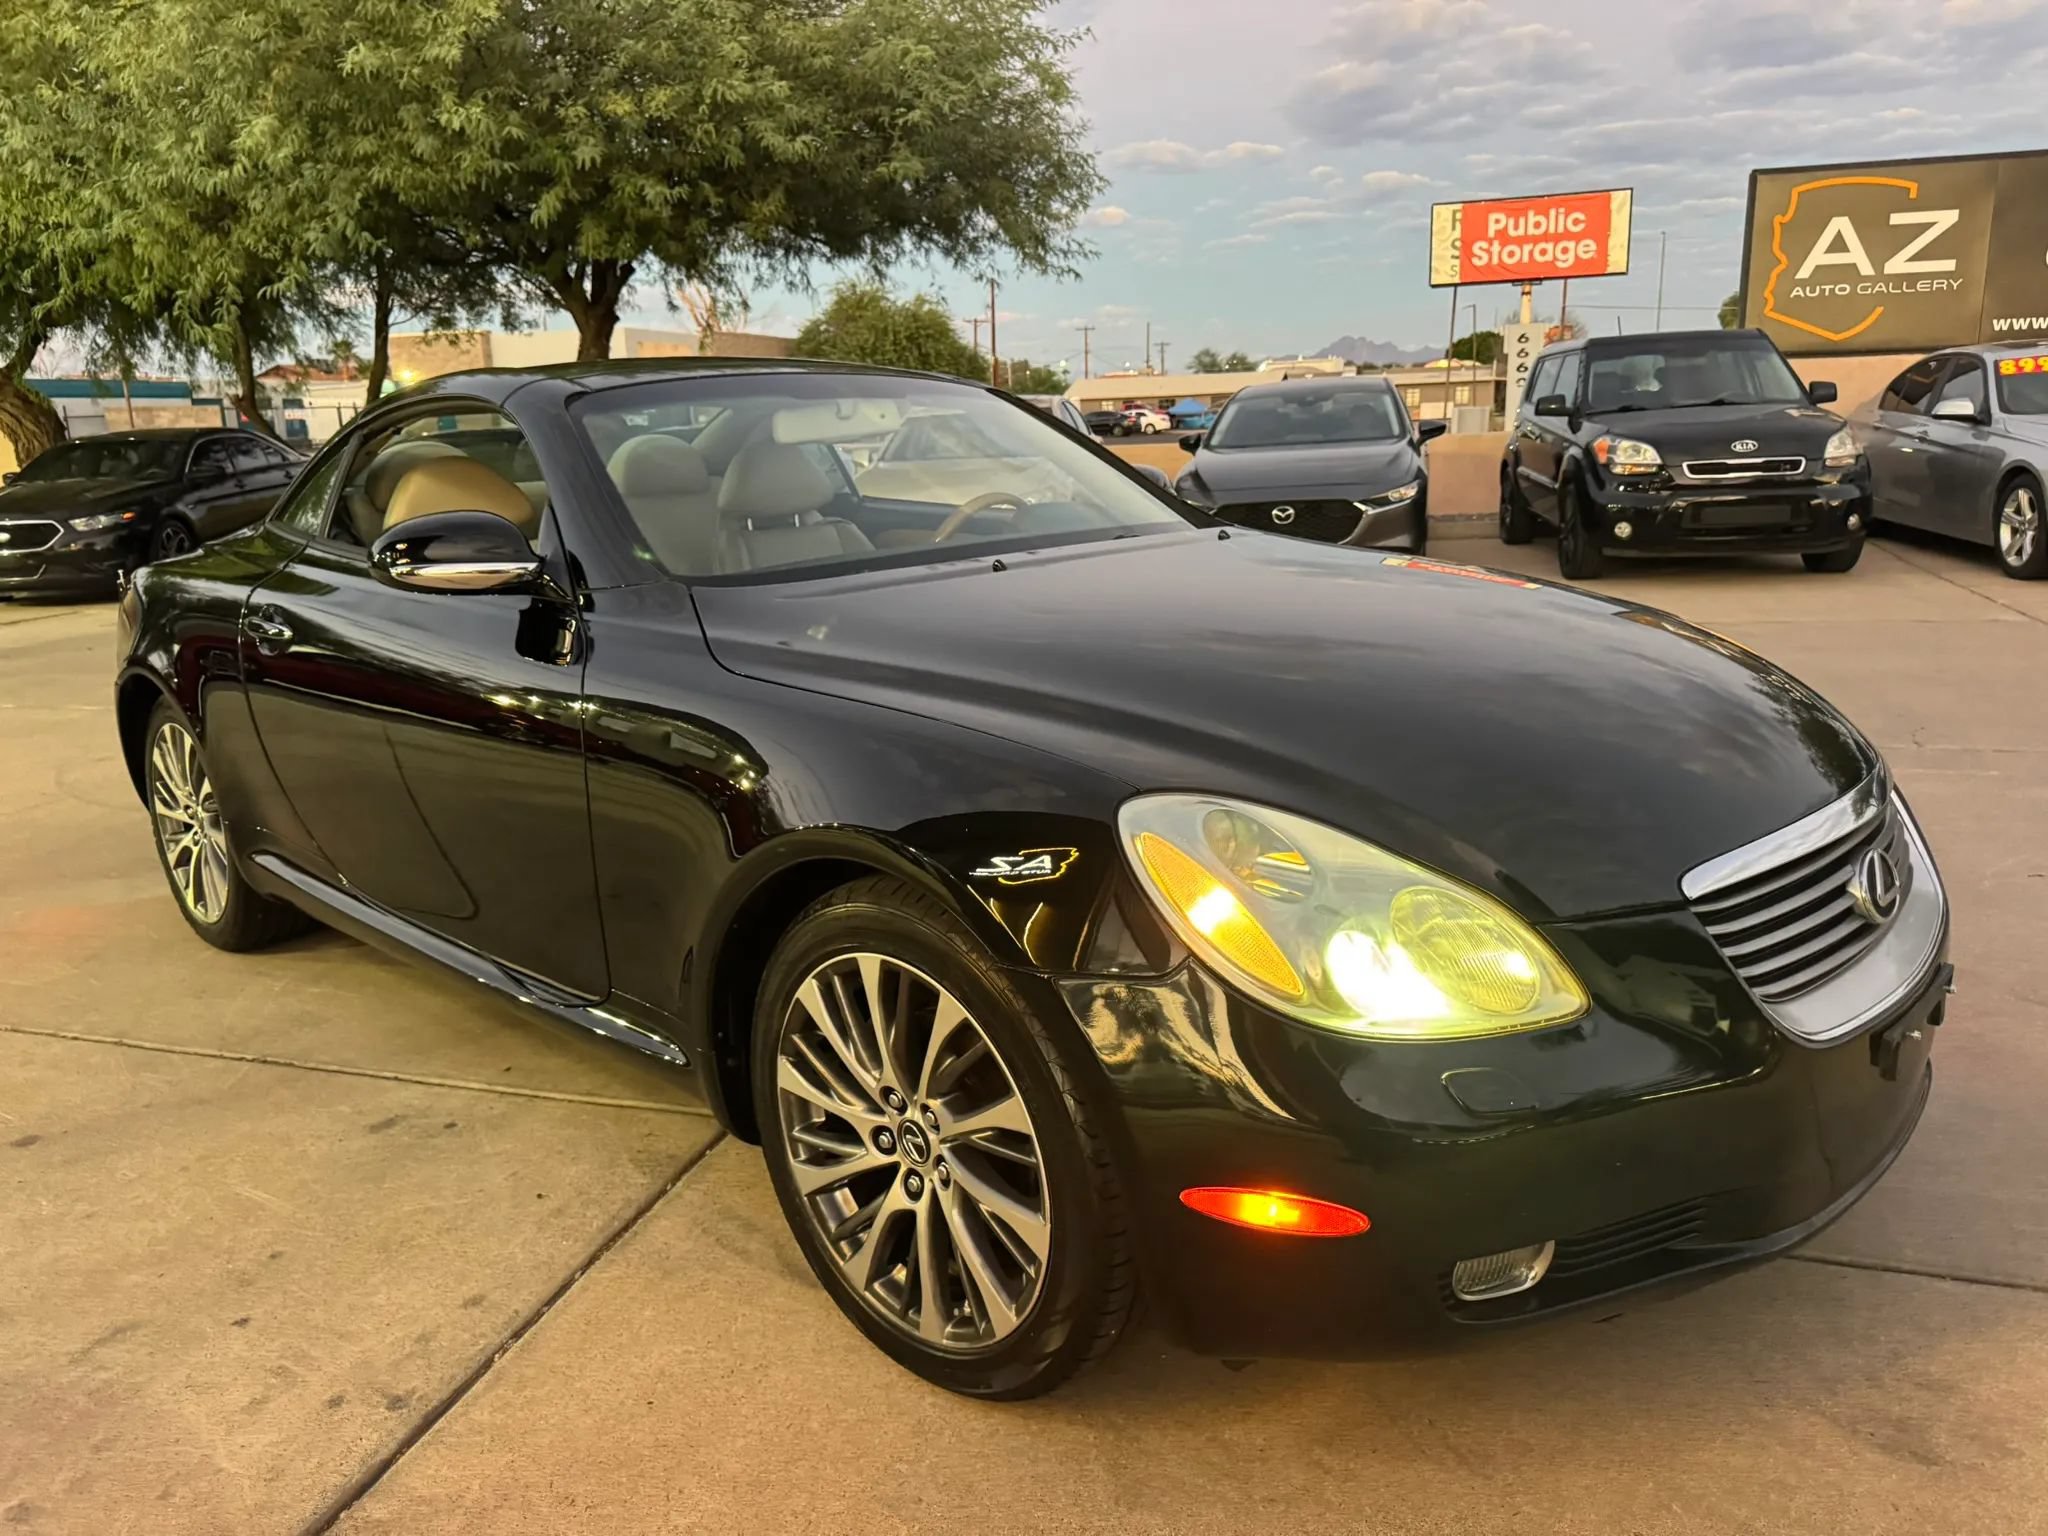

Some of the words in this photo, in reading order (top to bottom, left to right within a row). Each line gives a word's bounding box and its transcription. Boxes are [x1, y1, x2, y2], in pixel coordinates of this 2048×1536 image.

[1488, 208, 1586, 238] Public
[1471, 238, 1597, 268] Storage
[1794, 209, 1960, 279] AZ
[1790, 284, 1851, 298] AUTO
[1857, 278, 1963, 295] GALLERY
[1733, 442, 1756, 451] KIA
